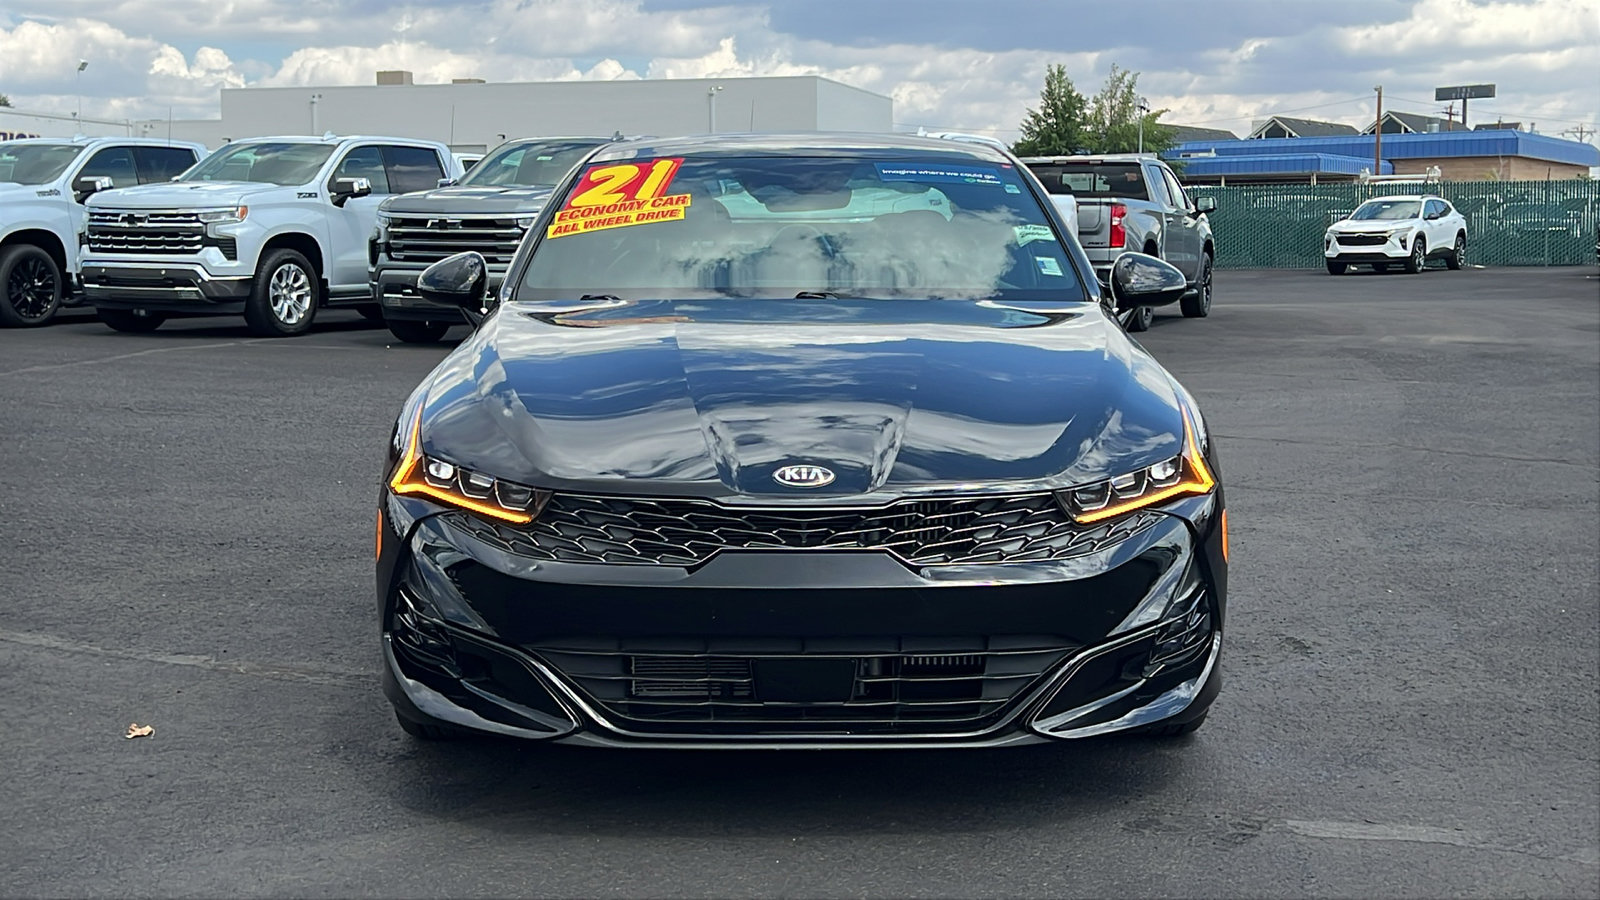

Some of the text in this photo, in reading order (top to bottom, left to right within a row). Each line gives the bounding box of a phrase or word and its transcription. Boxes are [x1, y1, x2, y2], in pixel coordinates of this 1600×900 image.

[570, 159, 677, 207] 21
[960, 171, 983, 179] could
[552, 208, 681, 235] ALL WHEEL DRIVE
[557, 195, 687, 222] ECONOMY CAR
[784, 467, 825, 481] KIA
